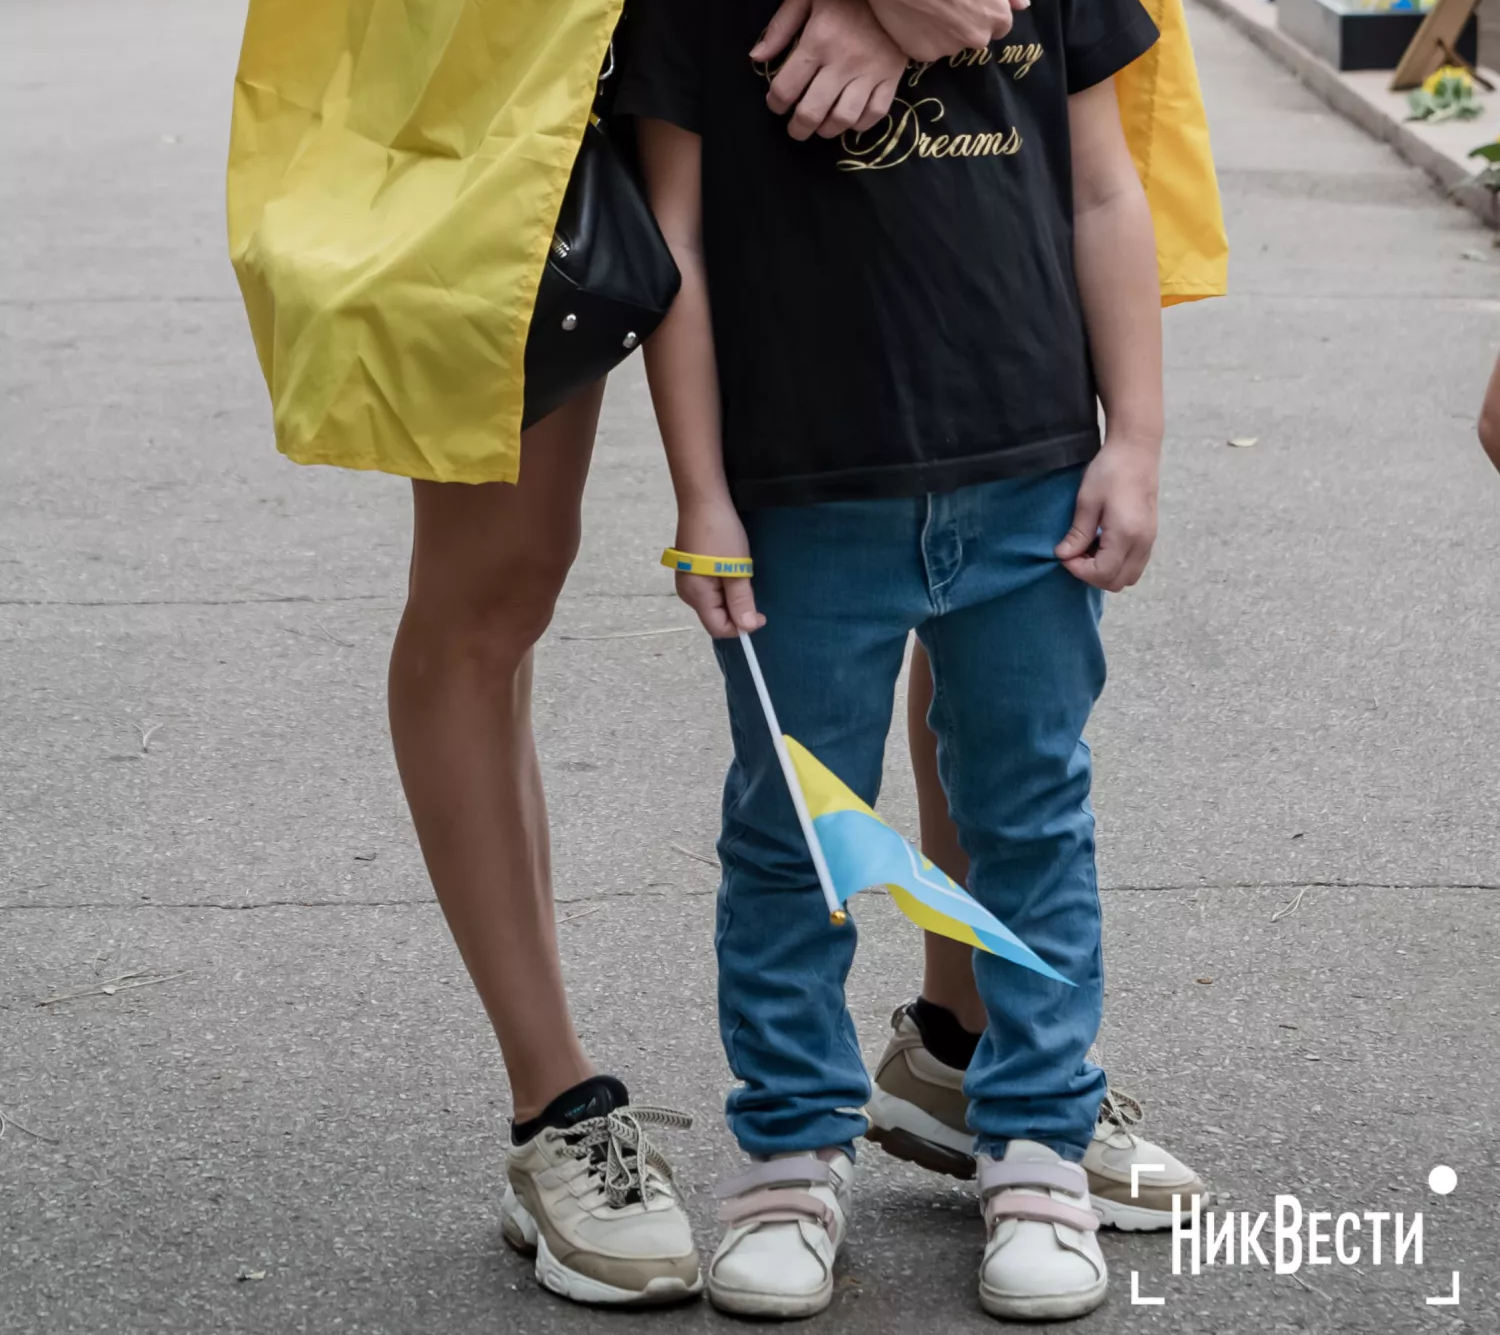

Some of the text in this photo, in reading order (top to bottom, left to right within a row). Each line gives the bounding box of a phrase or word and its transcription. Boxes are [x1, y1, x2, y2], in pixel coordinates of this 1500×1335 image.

[997, 42, 1044, 80] my
[836, 97, 1024, 172] Dreams
[714, 562, 753, 574] RAINE
